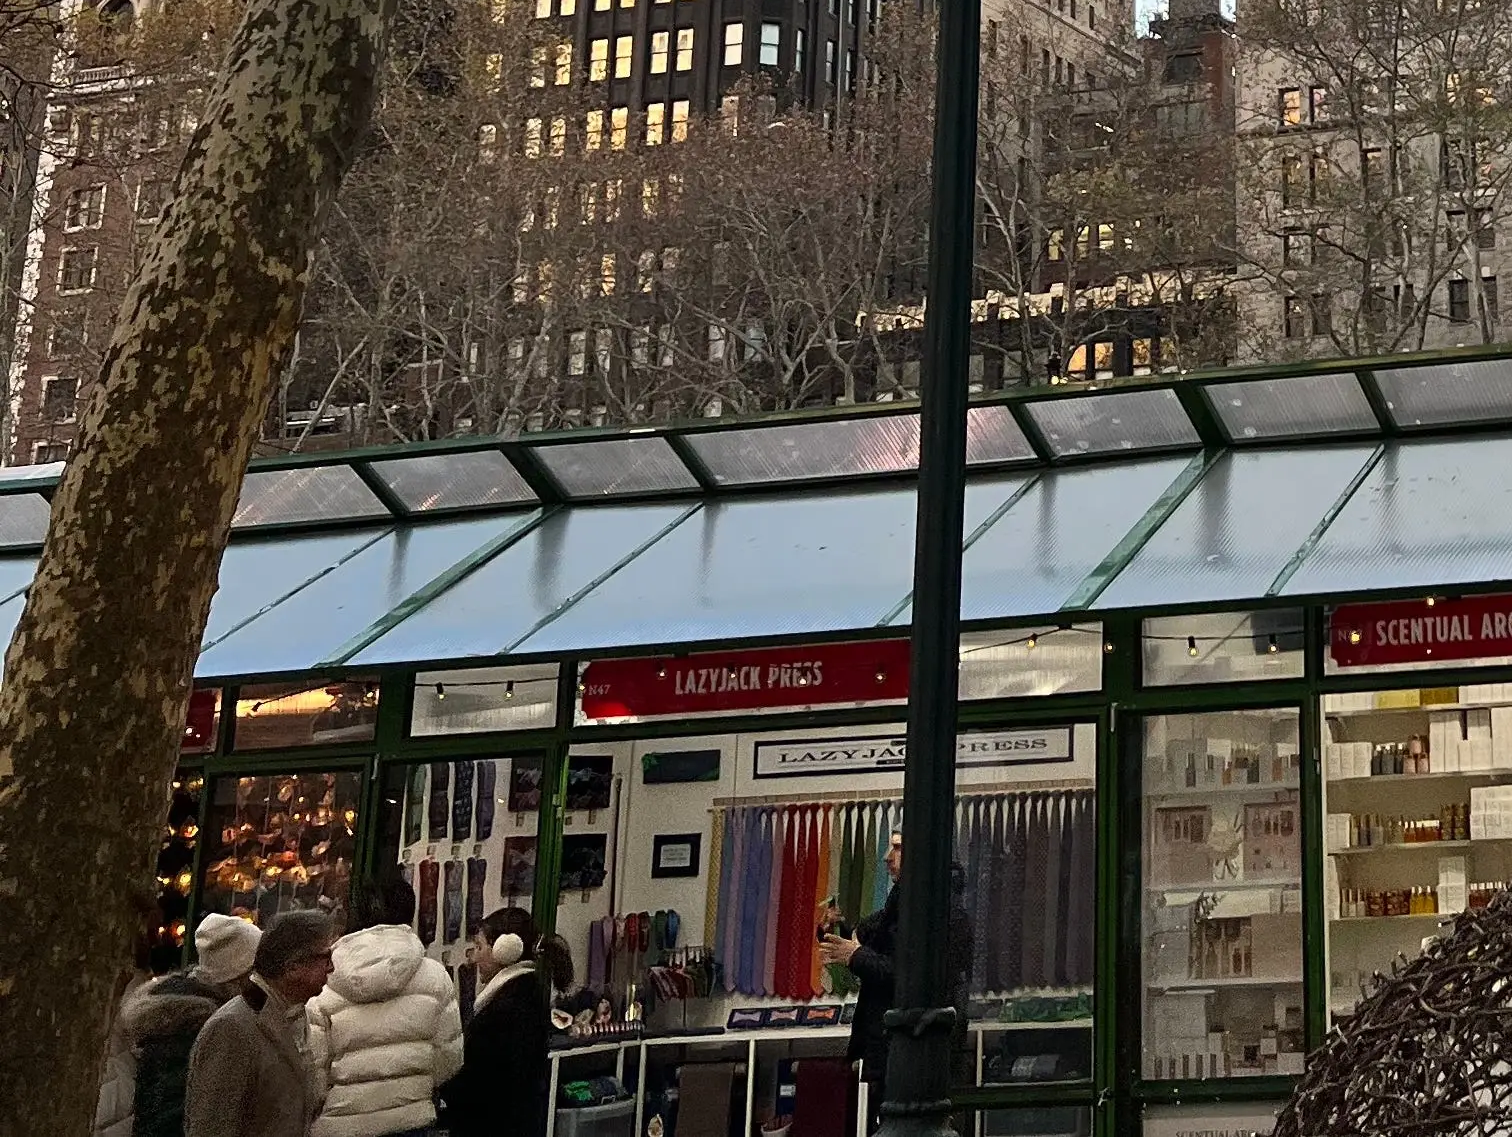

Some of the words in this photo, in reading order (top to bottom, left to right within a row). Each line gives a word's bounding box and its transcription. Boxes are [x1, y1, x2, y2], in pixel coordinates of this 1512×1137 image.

[1375, 614, 1473, 647] SCENTUAL
[675, 666, 761, 695] LAZYJACK
[768, 661, 823, 689] PRESS
[778, 745, 906, 763] LAZYJA
